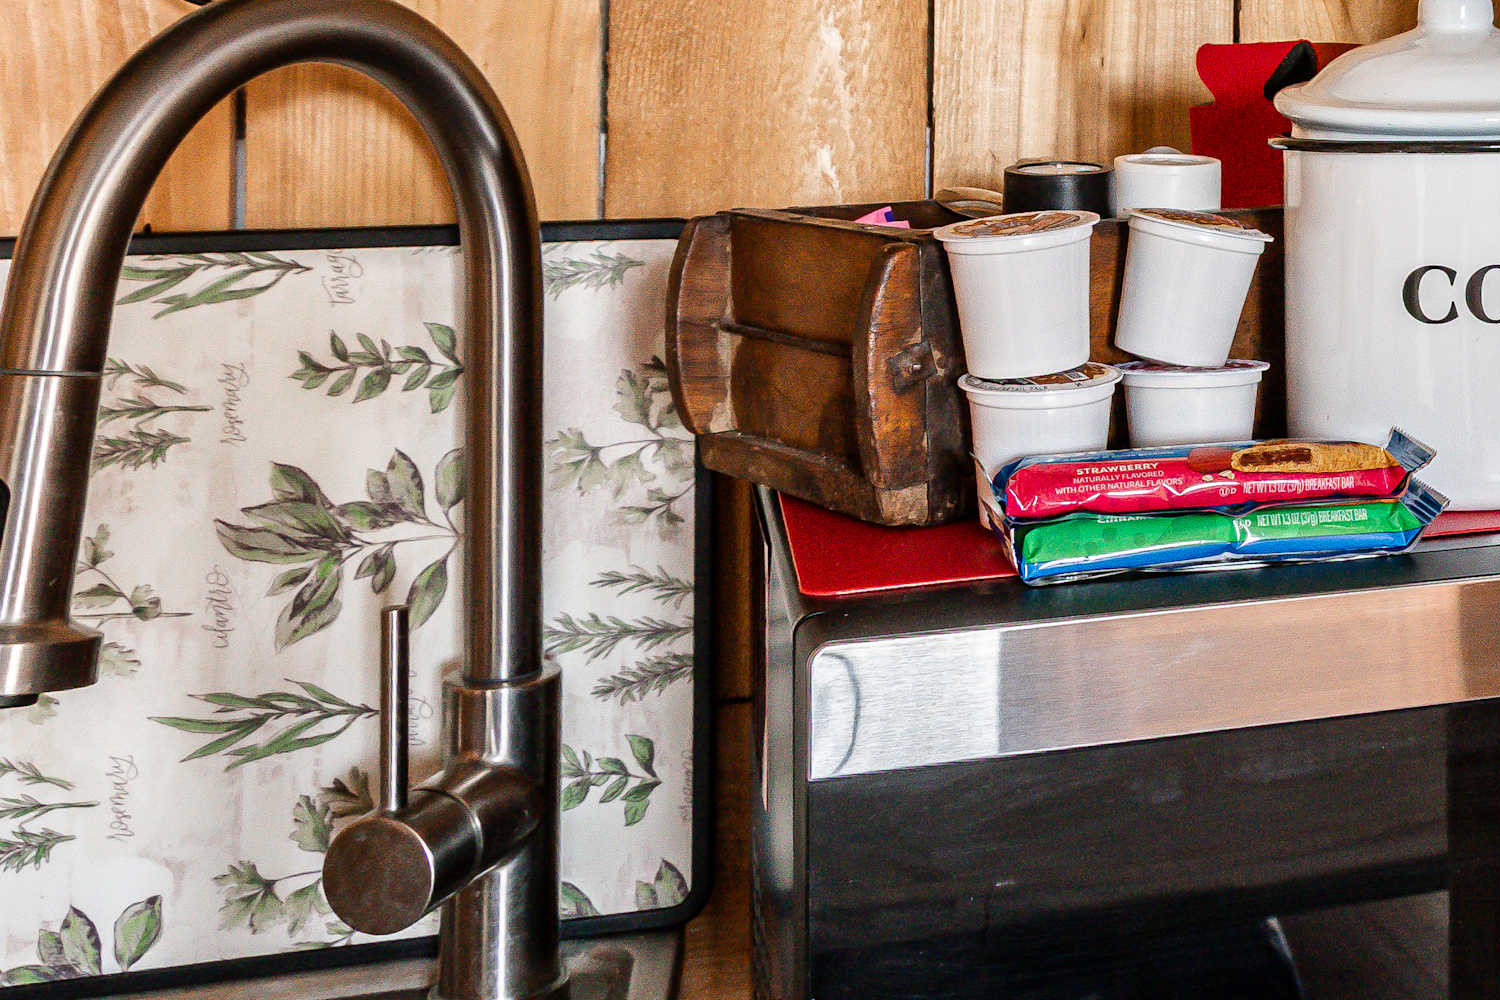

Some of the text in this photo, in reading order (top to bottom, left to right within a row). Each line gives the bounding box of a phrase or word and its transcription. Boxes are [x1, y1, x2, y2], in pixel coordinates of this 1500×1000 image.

[217, 362, 250, 447] rosemary
[1073, 470, 1164, 484] NATURALLY FLAVORED
[1076, 462, 1158, 476] STRAWBERRY
[1055, 477, 1183, 495] WITH OTHER NATURAL FLAVORS
[1243, 480, 1255, 494] NET
[1256, 480, 1267, 493] WT
[1305, 477, 1340, 491] BREAKFAST
[1341, 476, 1355, 489] BAR
[1257, 514, 1270, 527] NET
[1270, 513, 1281, 526] WT
[1282, 513, 1291, 525] 1.3
[1291, 512, 1300, 524] OZ
[1319, 509, 1352, 523] BREAKFAST
[1353, 508, 1368, 521] BAR
[105, 754, 139, 842] rosemary
